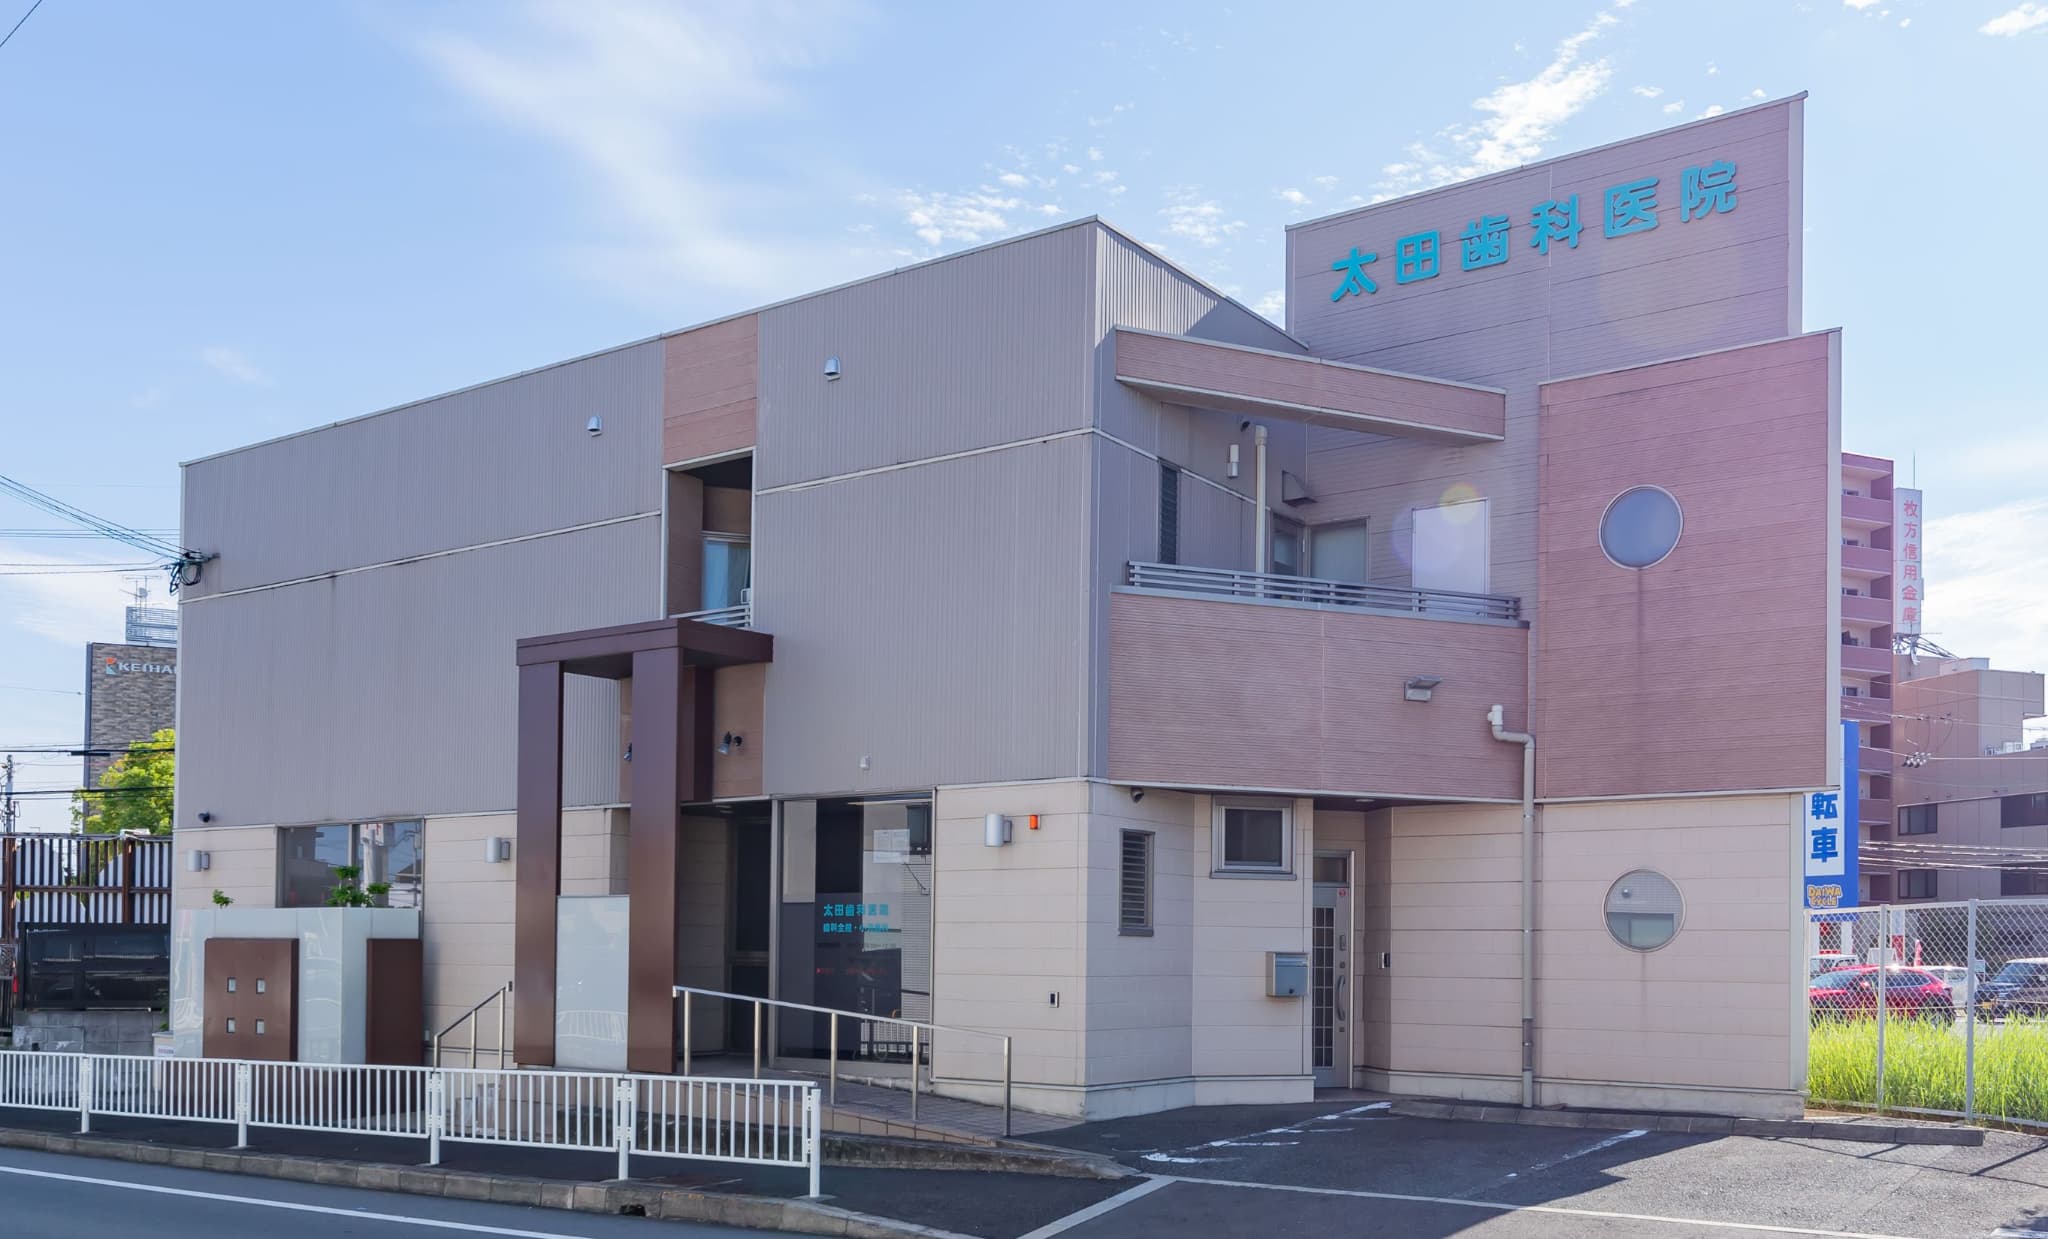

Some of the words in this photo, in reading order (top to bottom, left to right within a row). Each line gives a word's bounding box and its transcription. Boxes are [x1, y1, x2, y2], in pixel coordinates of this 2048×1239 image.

[1331, 160, 1739, 302] 太田歯科医院
[1902, 500, 1918, 622] 枚方信用金庫
[1811, 792, 1839, 863] 転車
[1808, 885, 1842, 898] DAIWA
